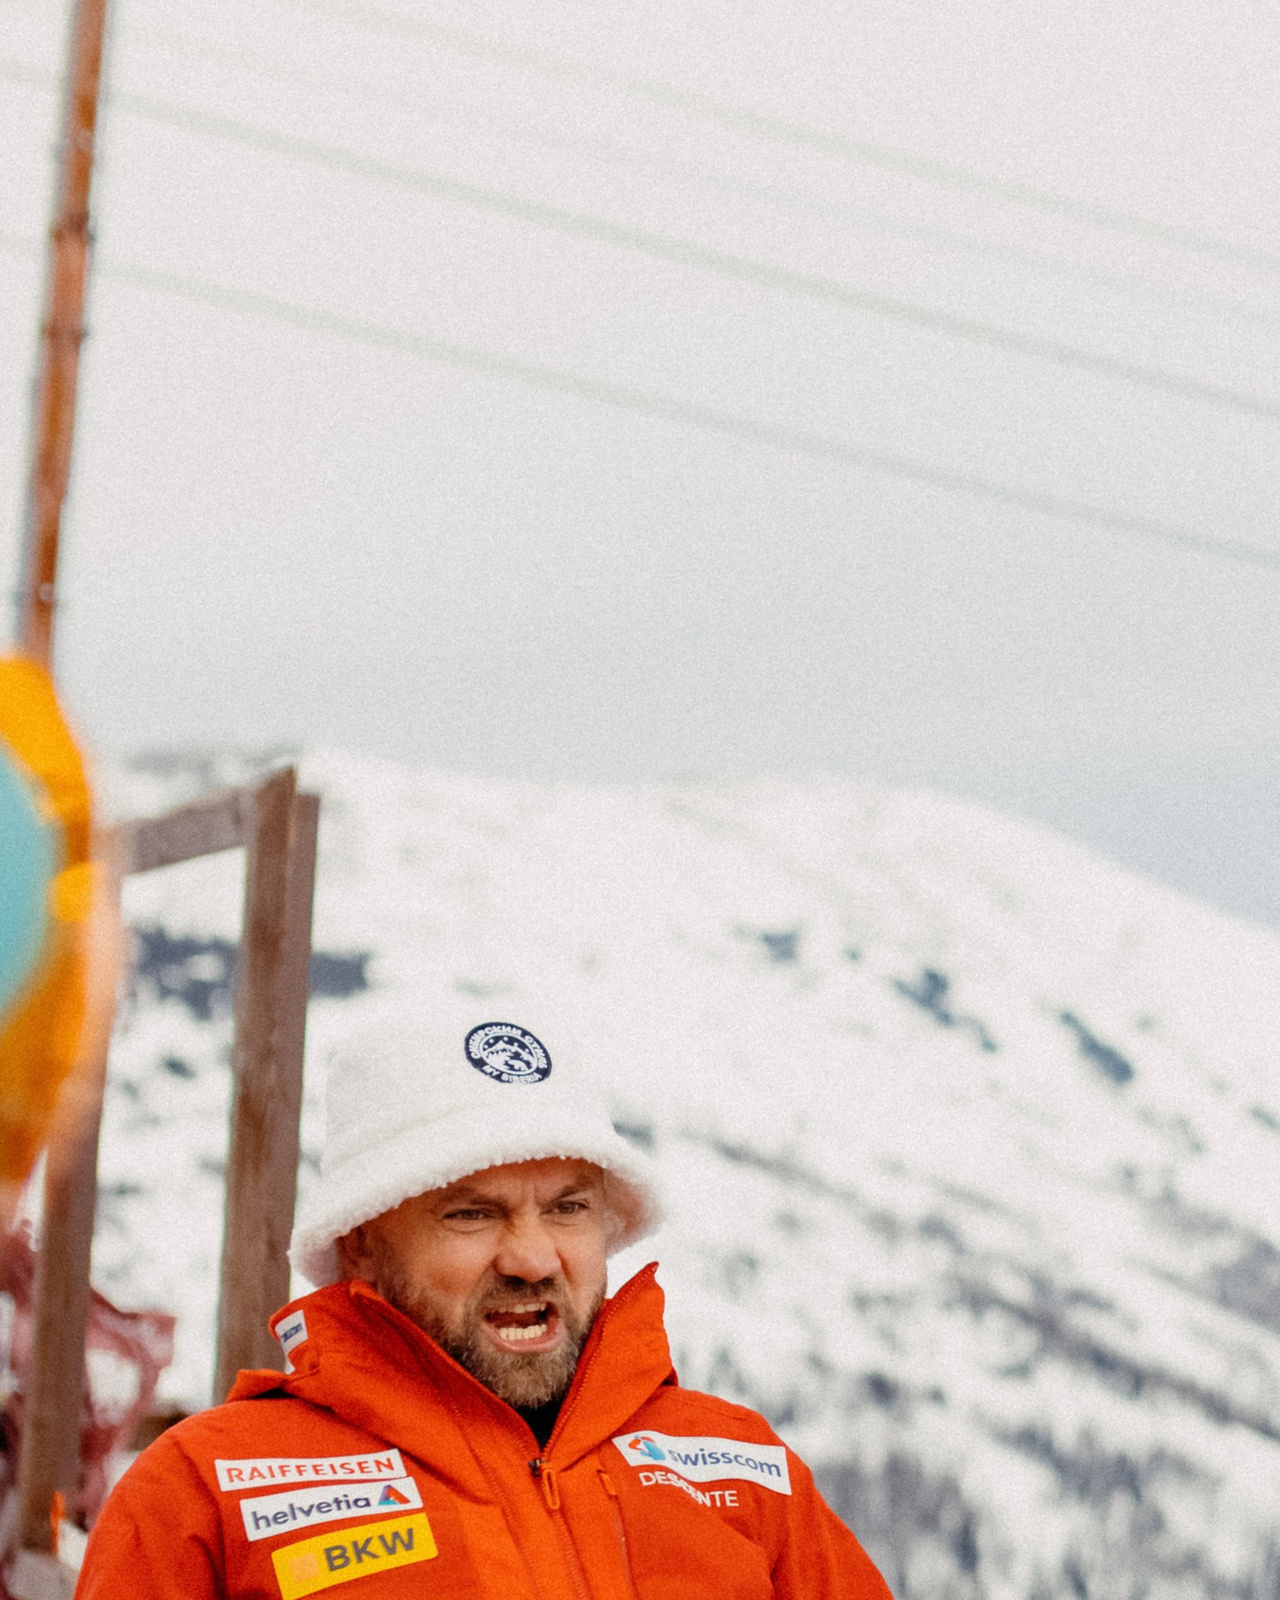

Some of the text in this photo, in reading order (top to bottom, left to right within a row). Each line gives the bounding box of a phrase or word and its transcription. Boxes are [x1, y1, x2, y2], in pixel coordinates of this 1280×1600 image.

[226, 1457, 395, 1483] RAIFFEISEN
[668, 1448, 782, 1478] swisscom
[251, 1494, 371, 1530] helvetia
[324, 1528, 414, 1572] BKW
